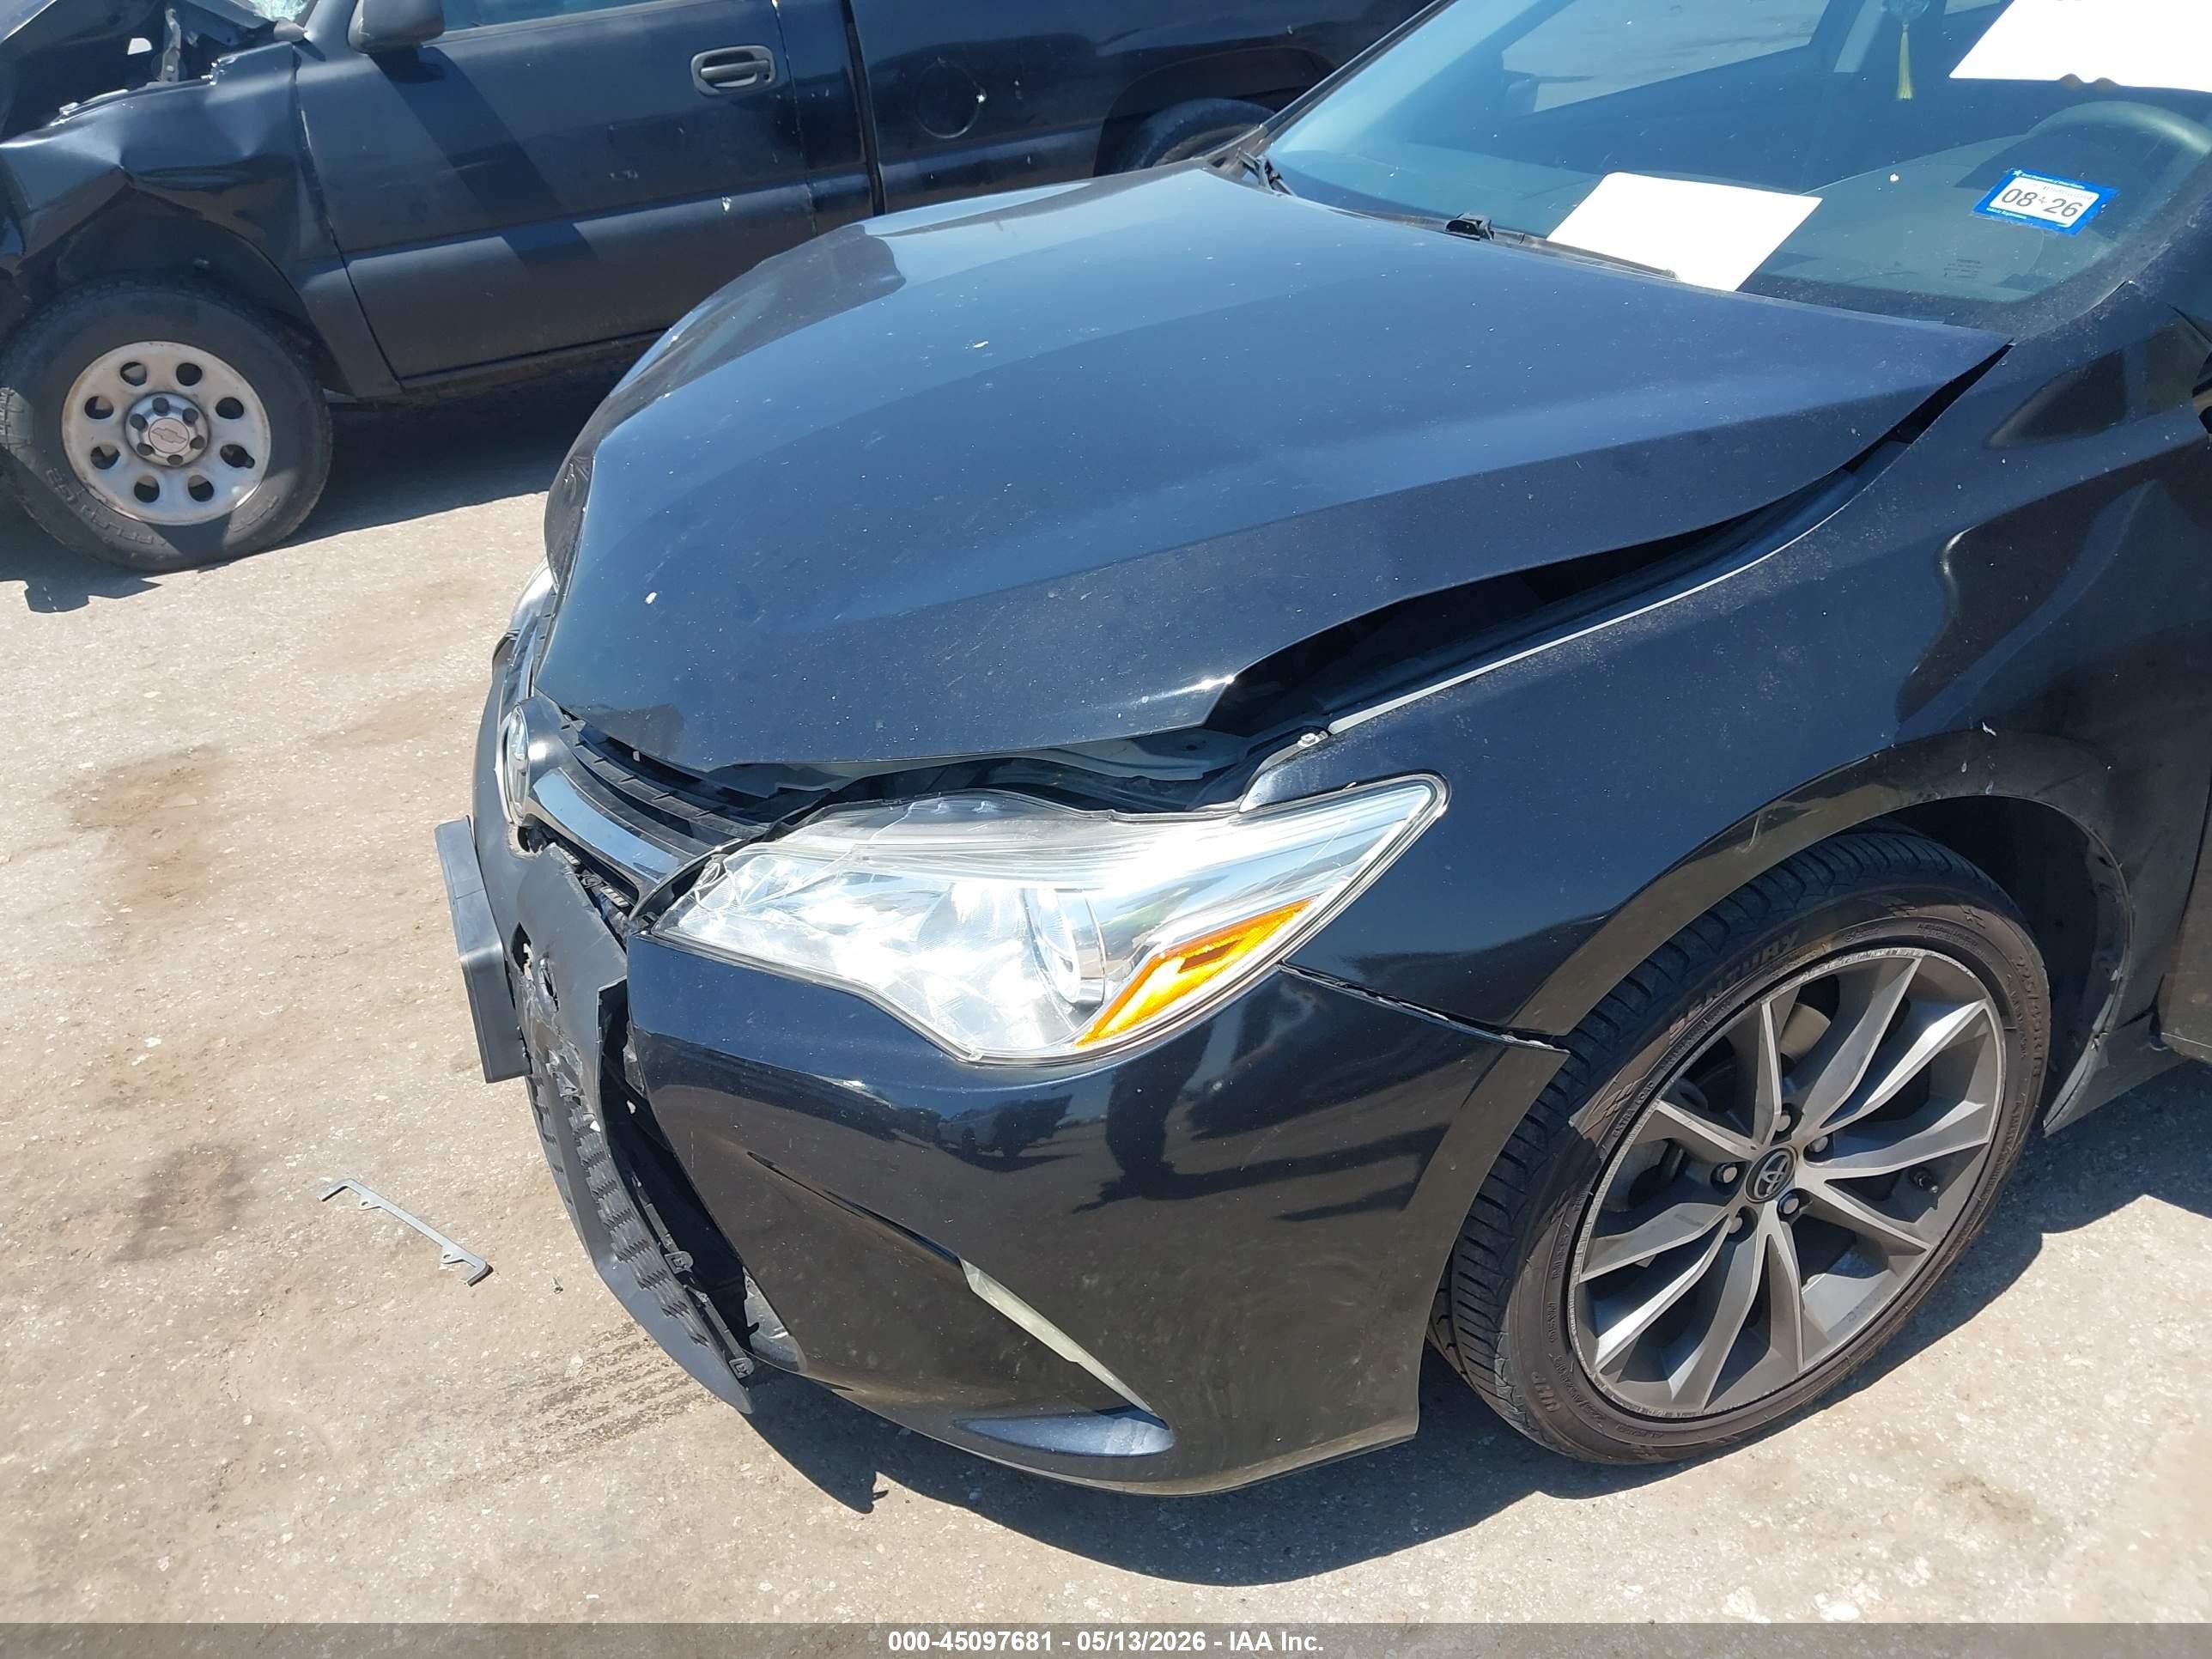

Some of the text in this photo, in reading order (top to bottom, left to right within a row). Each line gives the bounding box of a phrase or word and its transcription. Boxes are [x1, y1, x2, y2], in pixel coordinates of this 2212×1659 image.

[2002, 188, 2038, 207] 08
[2043, 198, 2082, 217] 26
[1635, 1080, 1655, 1106] LOAD
